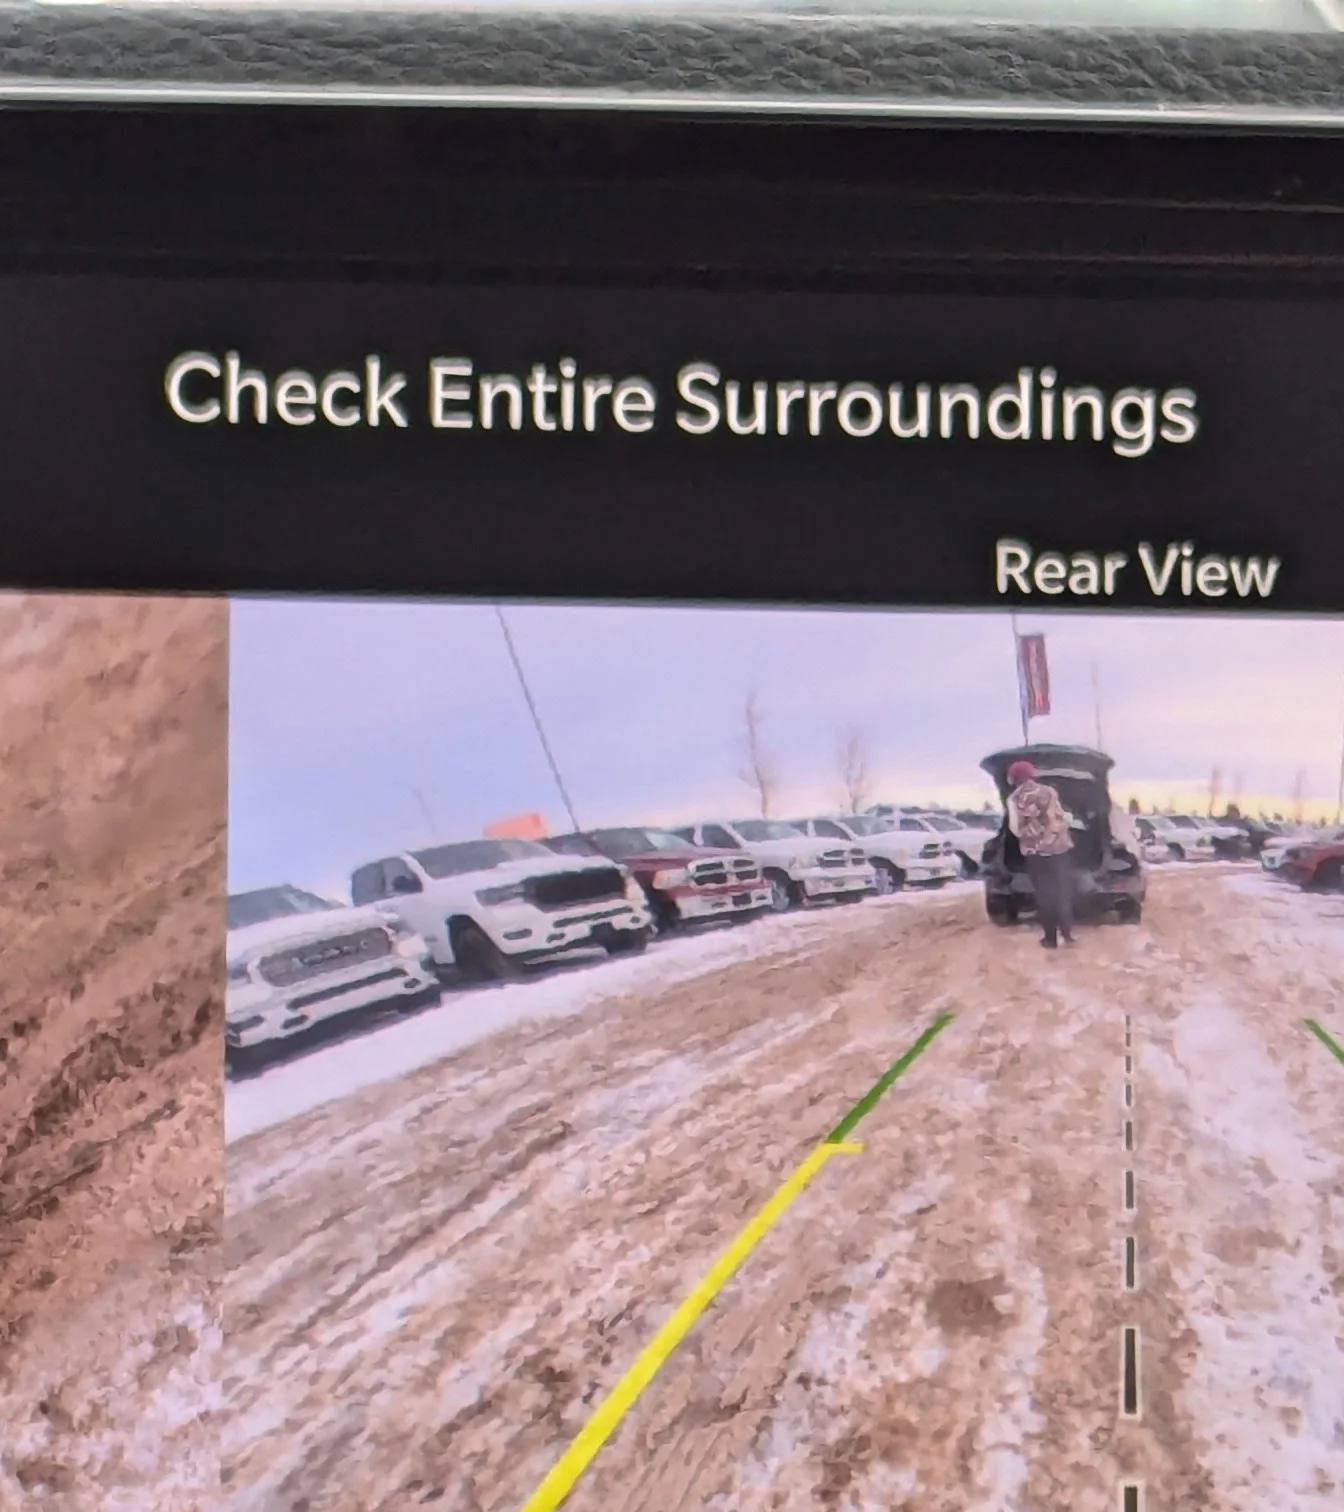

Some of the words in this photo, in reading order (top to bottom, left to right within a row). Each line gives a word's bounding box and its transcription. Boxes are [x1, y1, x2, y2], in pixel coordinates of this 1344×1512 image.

[163, 349, 409, 430] Check
[426, 355, 657, 435] Entire
[672, 359, 1199, 460] Surroundings
[993, 538, 1129, 598] Rear
[1134, 541, 1282, 599] View
